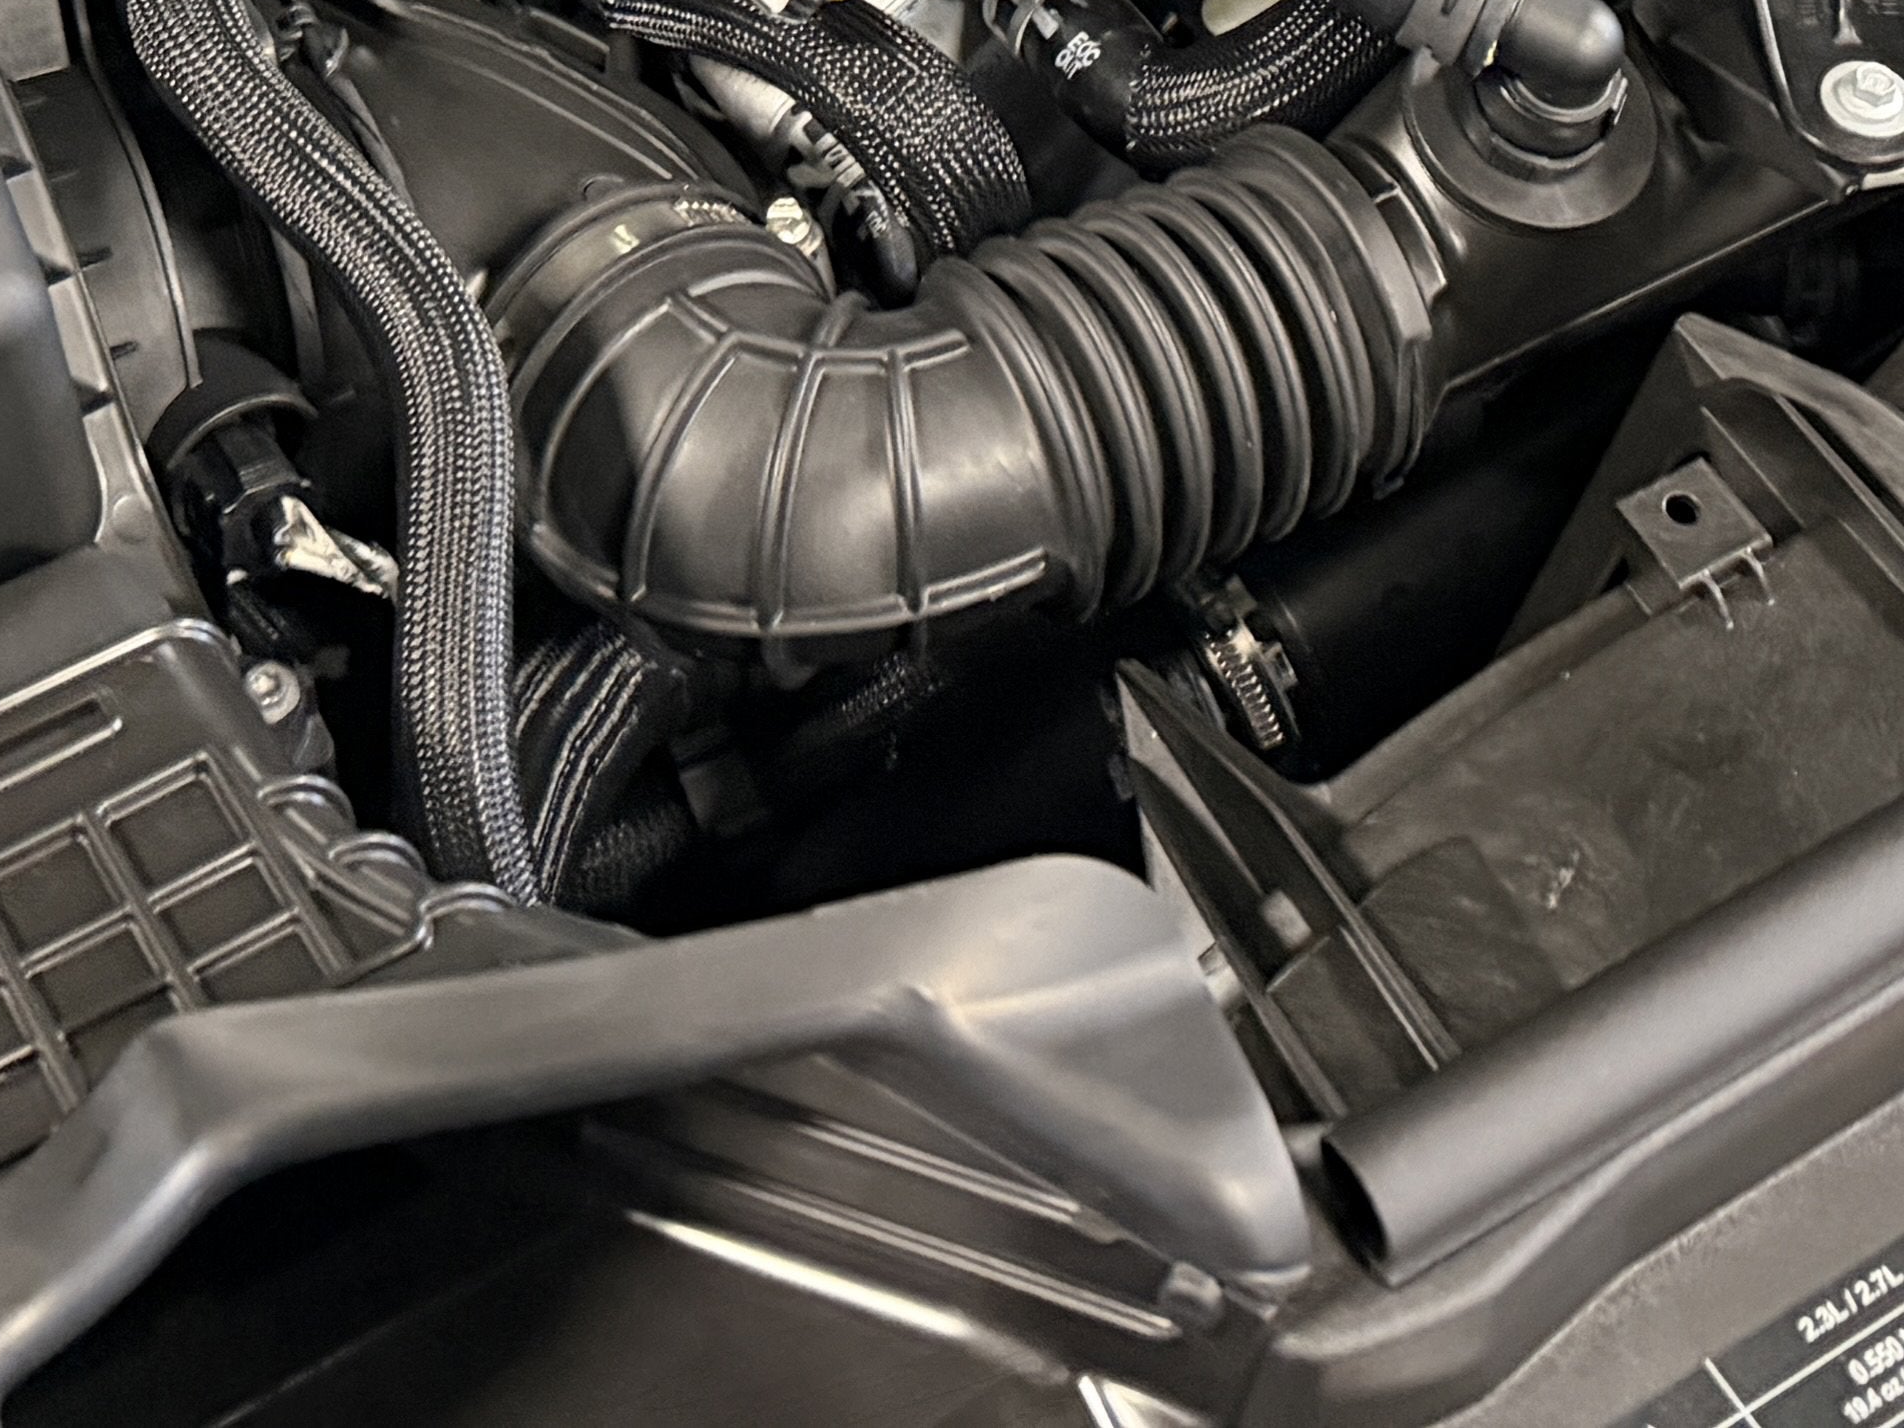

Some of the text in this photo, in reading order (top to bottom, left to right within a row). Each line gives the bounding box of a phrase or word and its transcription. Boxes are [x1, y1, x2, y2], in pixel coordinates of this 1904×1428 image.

[1798, 1299, 1850, 1344] 2.3L
[1854, 1263, 1904, 1307] 2.7L
[1848, 1335, 1904, 1385] 0.550
